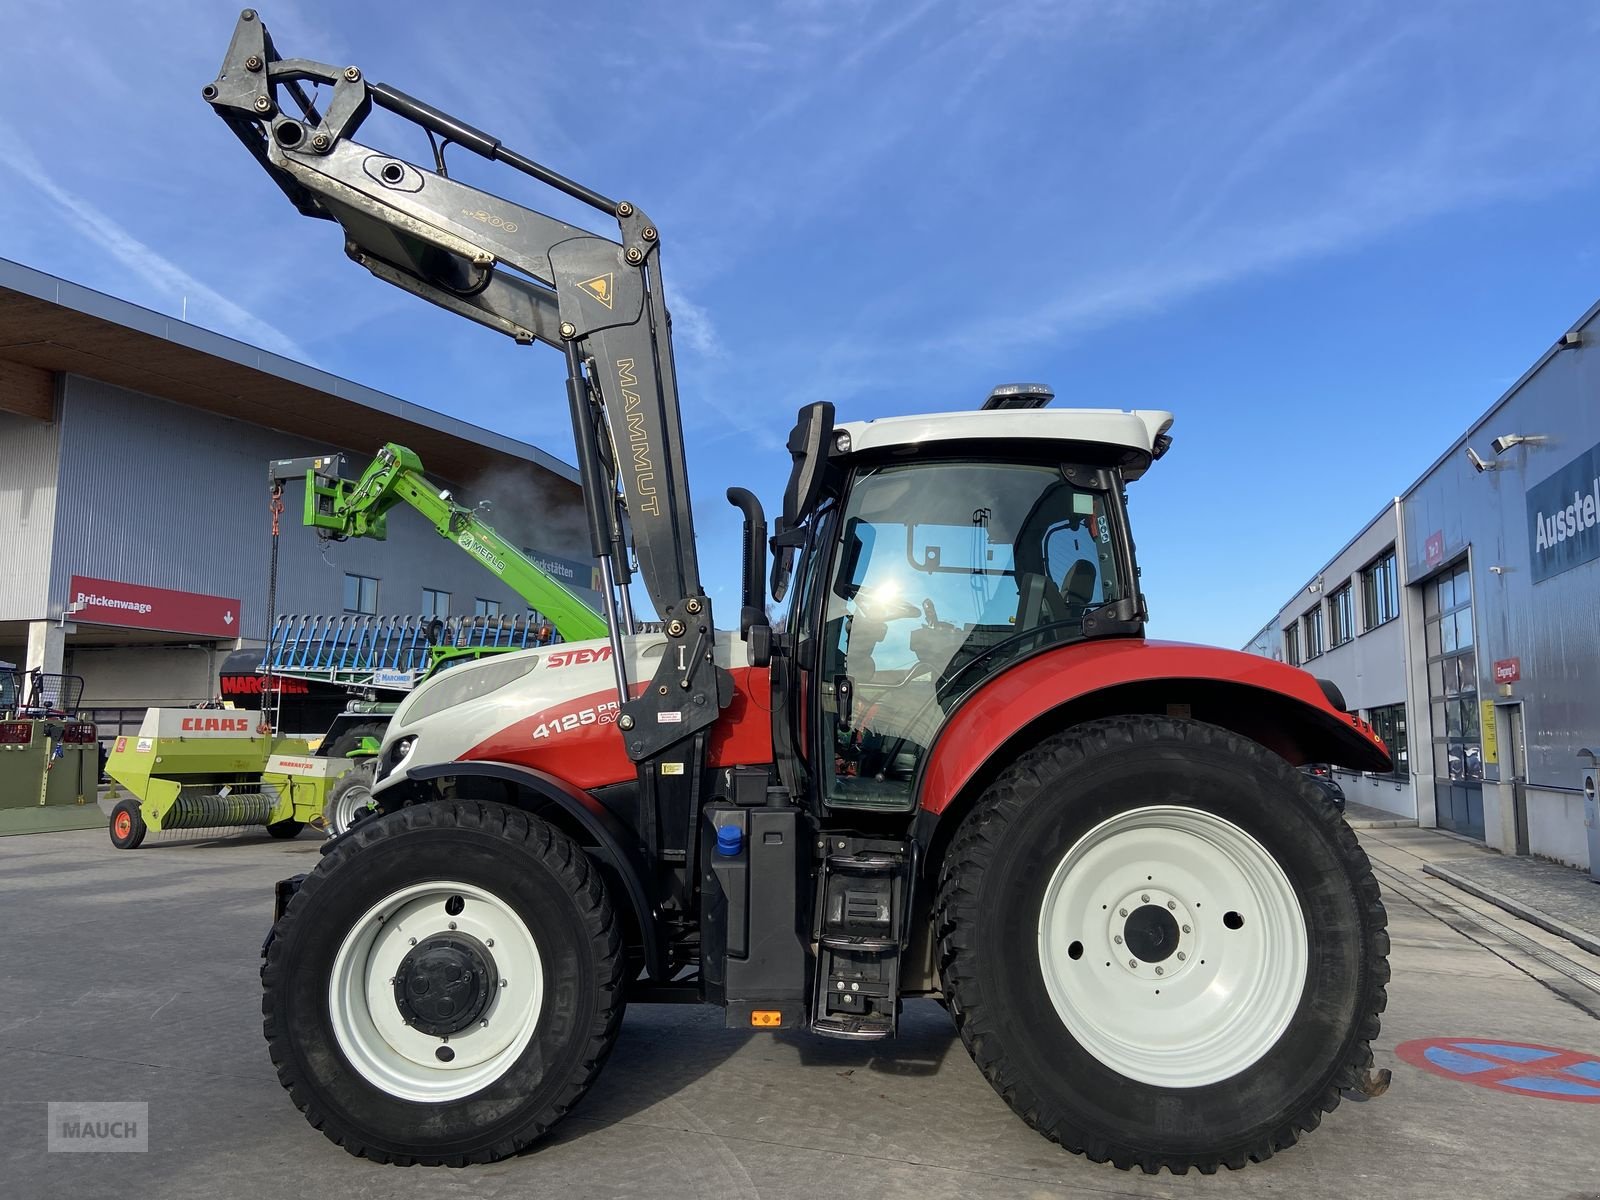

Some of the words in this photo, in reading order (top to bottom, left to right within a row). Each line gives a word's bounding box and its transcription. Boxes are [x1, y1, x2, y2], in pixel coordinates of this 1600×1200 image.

[472, 210, 518, 233] 200
[617, 358, 660, 517] MAMMUT
[472, 541, 505, 571] MERLO
[77, 592, 152, 613] Brückenwaage
[182, 718, 248, 731] CLAAS
[532, 708, 597, 739] 4125
[597, 701, 620, 713] PR
[598, 710, 620, 726] CV
